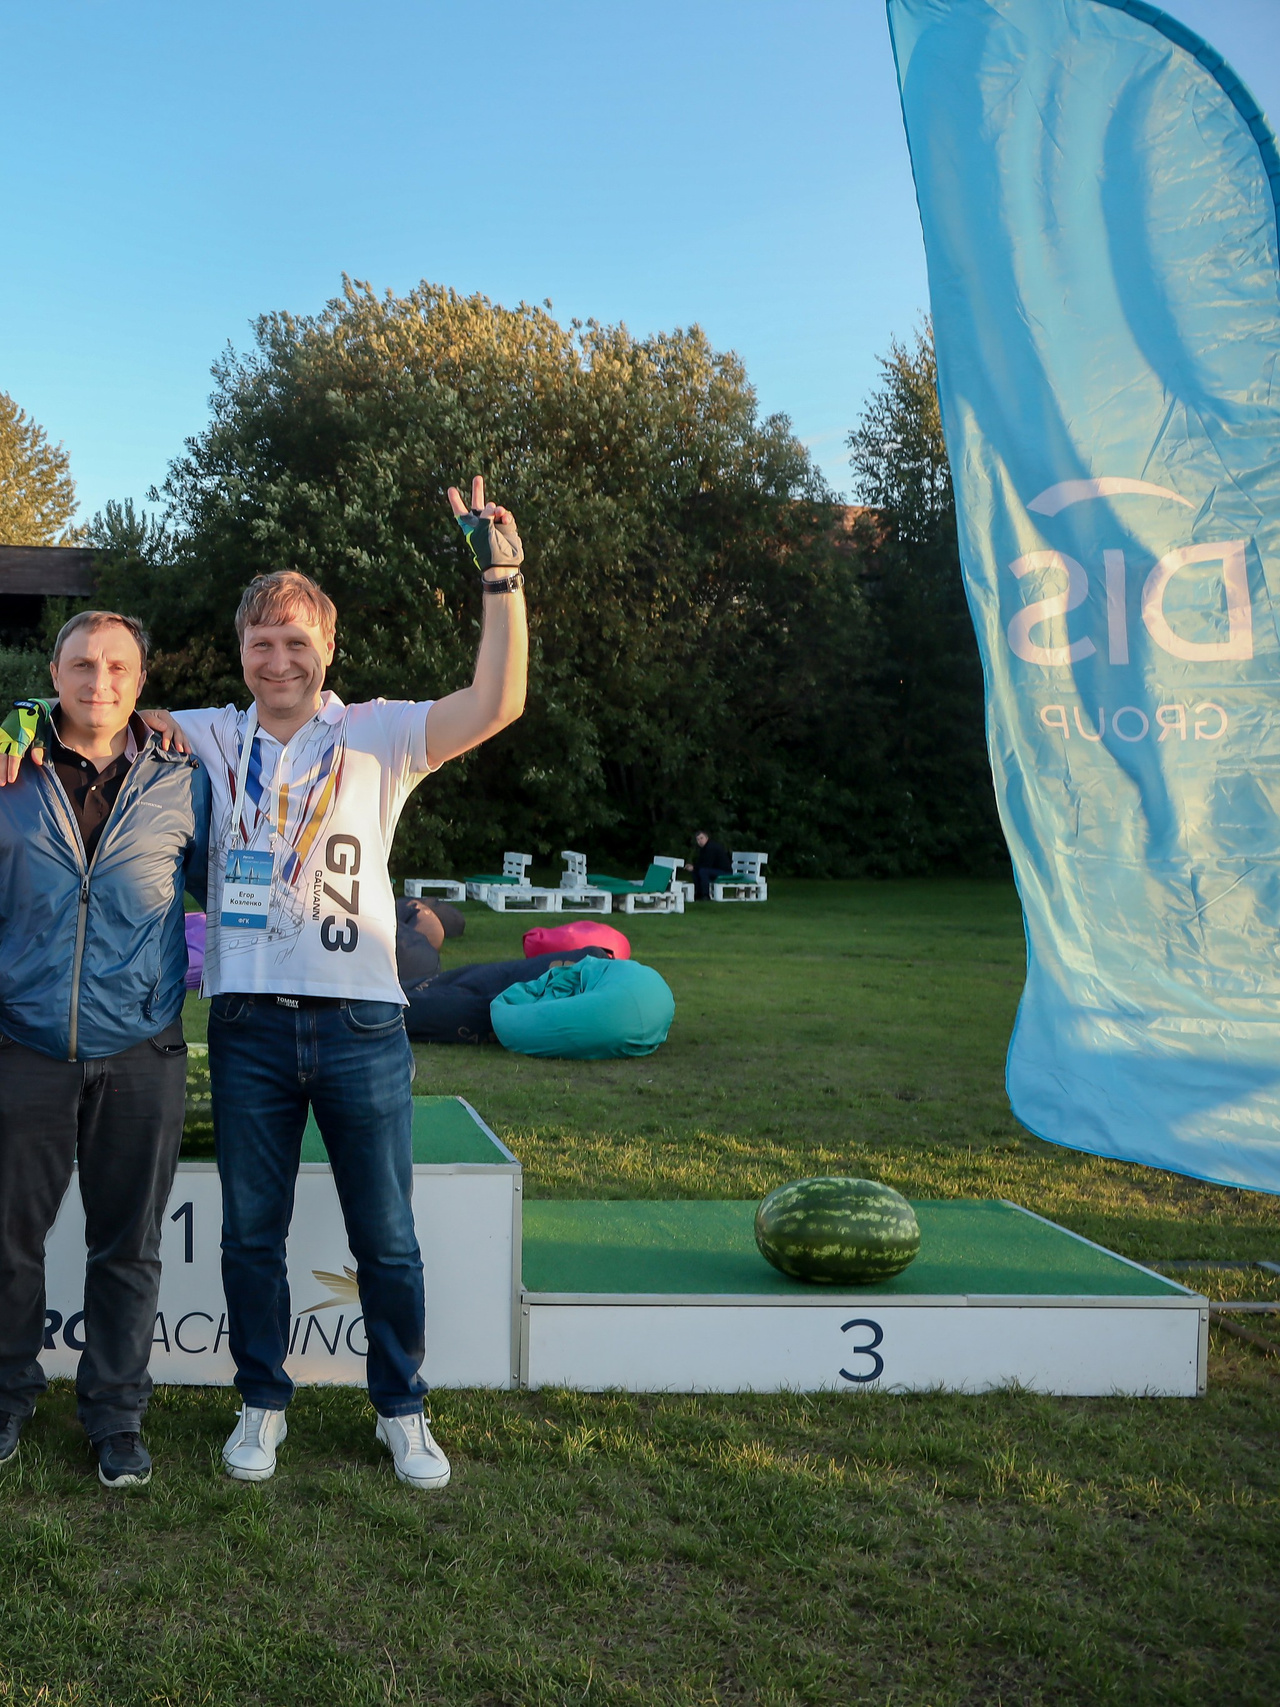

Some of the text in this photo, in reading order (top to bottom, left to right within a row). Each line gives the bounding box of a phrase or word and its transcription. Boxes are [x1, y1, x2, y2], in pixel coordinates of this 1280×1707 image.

[229, 898, 262, 907] Козленко
[238, 891, 255, 900] Егор
[312, 869, 322, 920] GALVANNI
[320, 833, 362, 954] G73
[277, 996, 299, 1005] TOMMY
[171, 1202, 193, 1264] 1
[838, 1318, 884, 1383] 3
